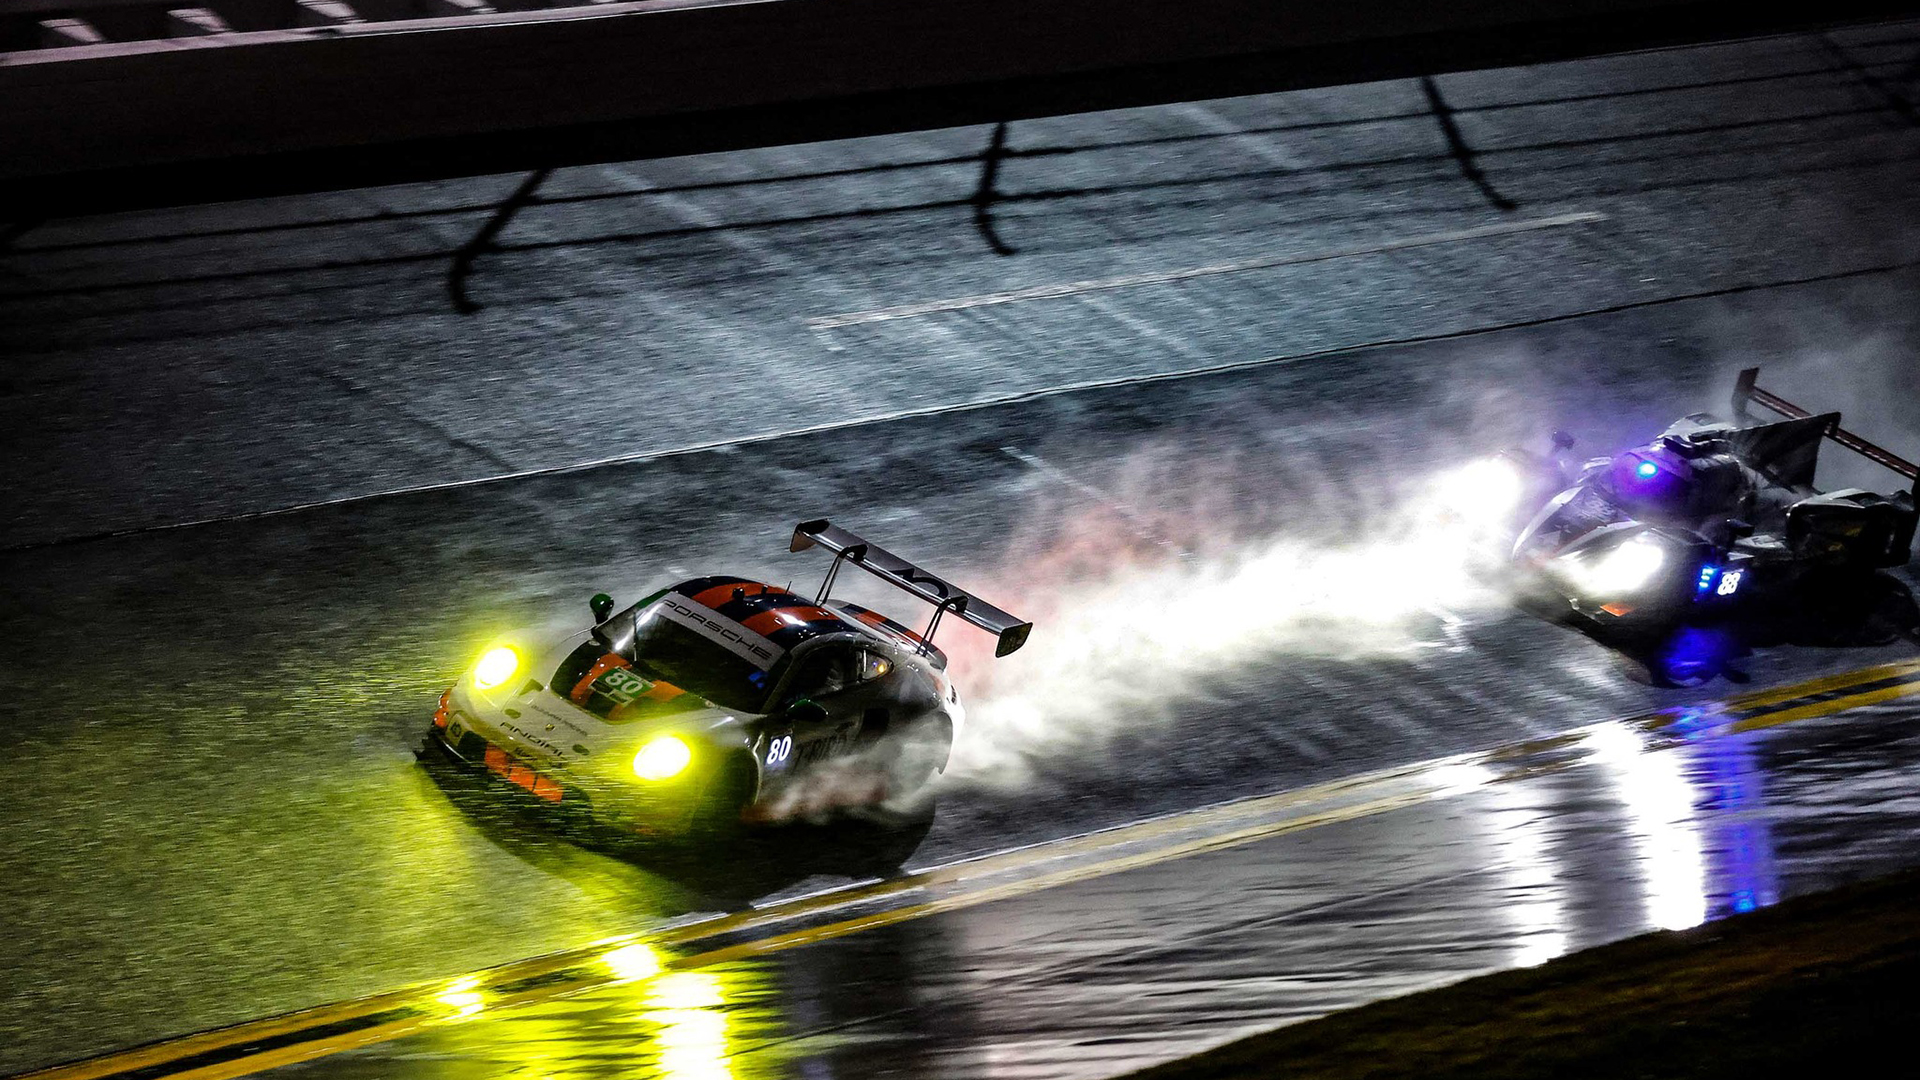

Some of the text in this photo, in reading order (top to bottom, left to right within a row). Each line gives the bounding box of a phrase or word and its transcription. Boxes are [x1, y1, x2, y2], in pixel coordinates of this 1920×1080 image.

[1717, 572, 1741, 595] 88
[662, 599, 773, 660] PORSCHE
[605, 671, 643, 694] 80
[500, 721, 563, 757] ANDIAL
[766, 735, 792, 764] 80
